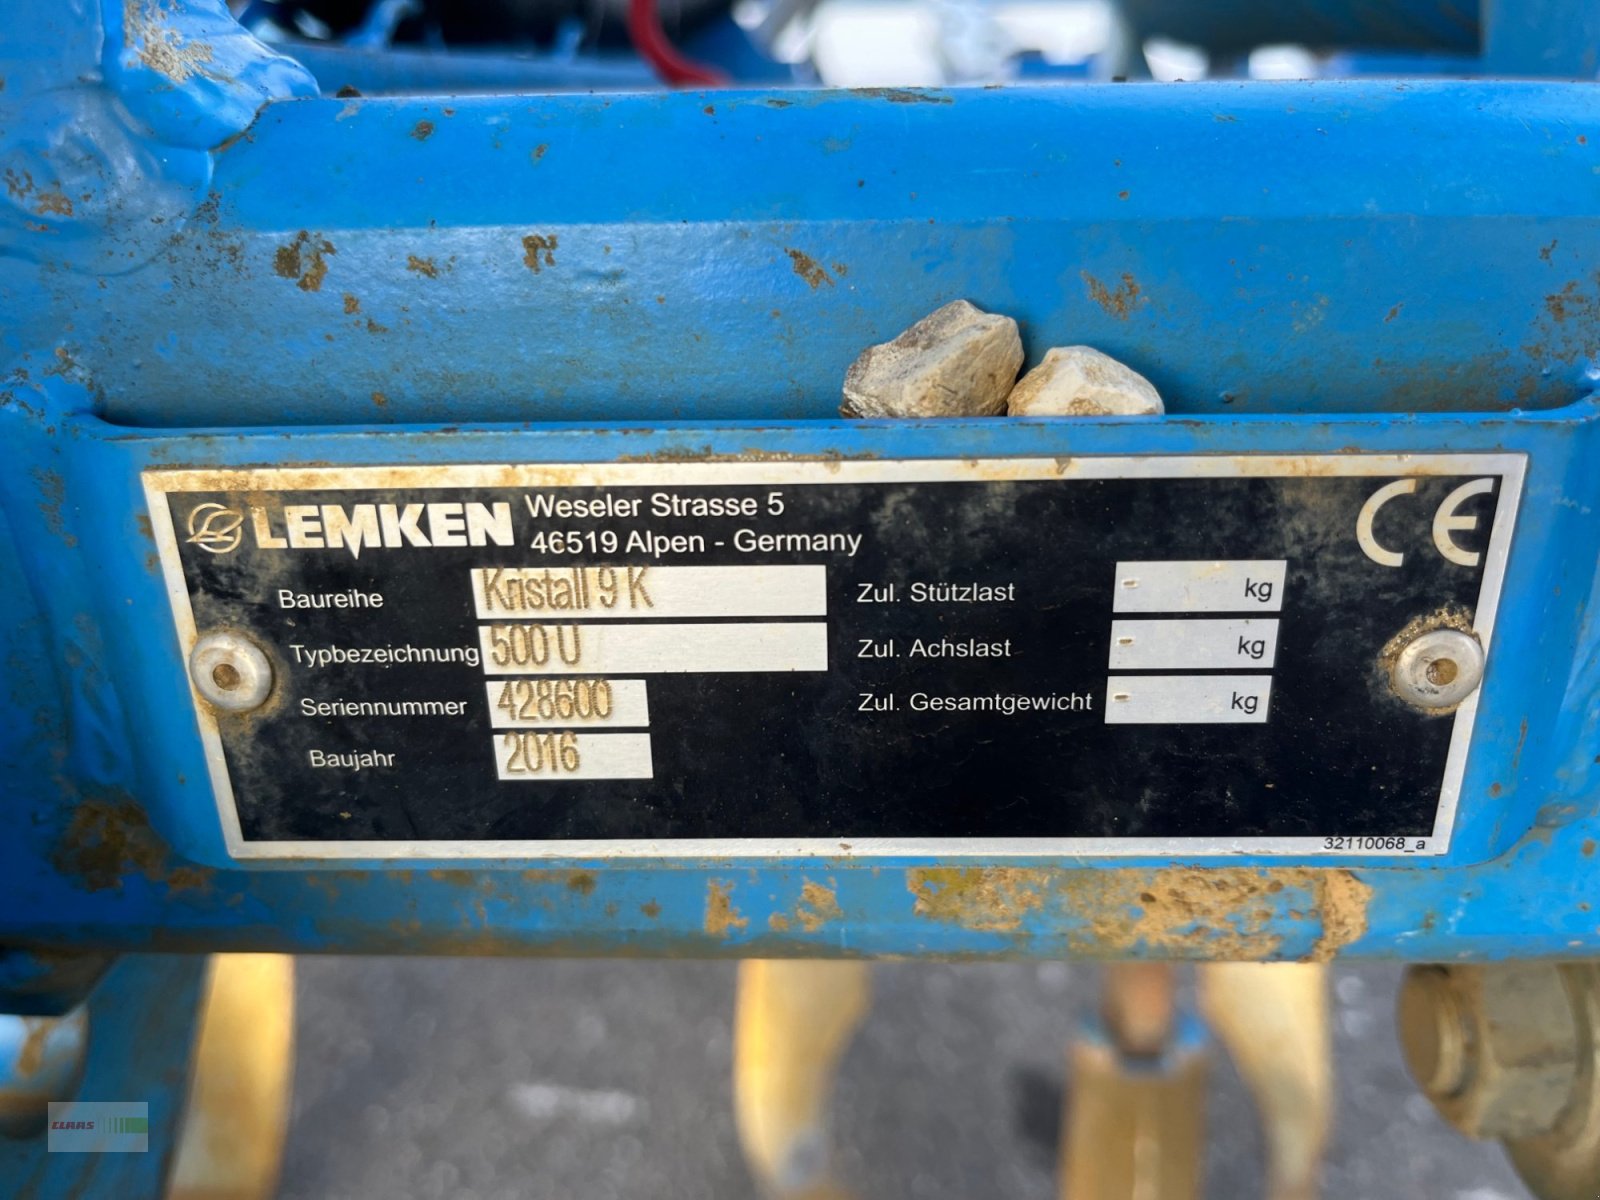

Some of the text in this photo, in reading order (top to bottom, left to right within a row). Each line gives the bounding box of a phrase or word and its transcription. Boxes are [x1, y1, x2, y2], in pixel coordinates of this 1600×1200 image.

[525, 492, 785, 518] Weseler Strasse 5
[250, 502, 514, 560] LEMKEN
[530, 530, 618, 554] 46519
[625, 530, 705, 558] Alpen
[734, 529, 862, 557] Germany
[279, 588, 384, 609] Baureihe
[482, 564, 655, 611] Kristall 9 K
[857, 582, 1015, 603] Zul. Stützlast
[1244, 578, 1273, 602] kg
[290, 644, 480, 668] Typbezeichnung
[491, 622, 582, 668] 500 U
[857, 638, 1011, 658] Zul. Achslast
[1237, 635, 1266, 659] kg
[301, 697, 468, 717] Seriennummer
[497, 678, 612, 721] 428600
[858, 692, 1093, 716] Zul. Gesamtgewicht
[1231, 691, 1259, 715] kg
[310, 750, 395, 771] Baujahr
[505, 730, 580, 774] 2016
[1324, 836, 1426, 853] 32110068_a
